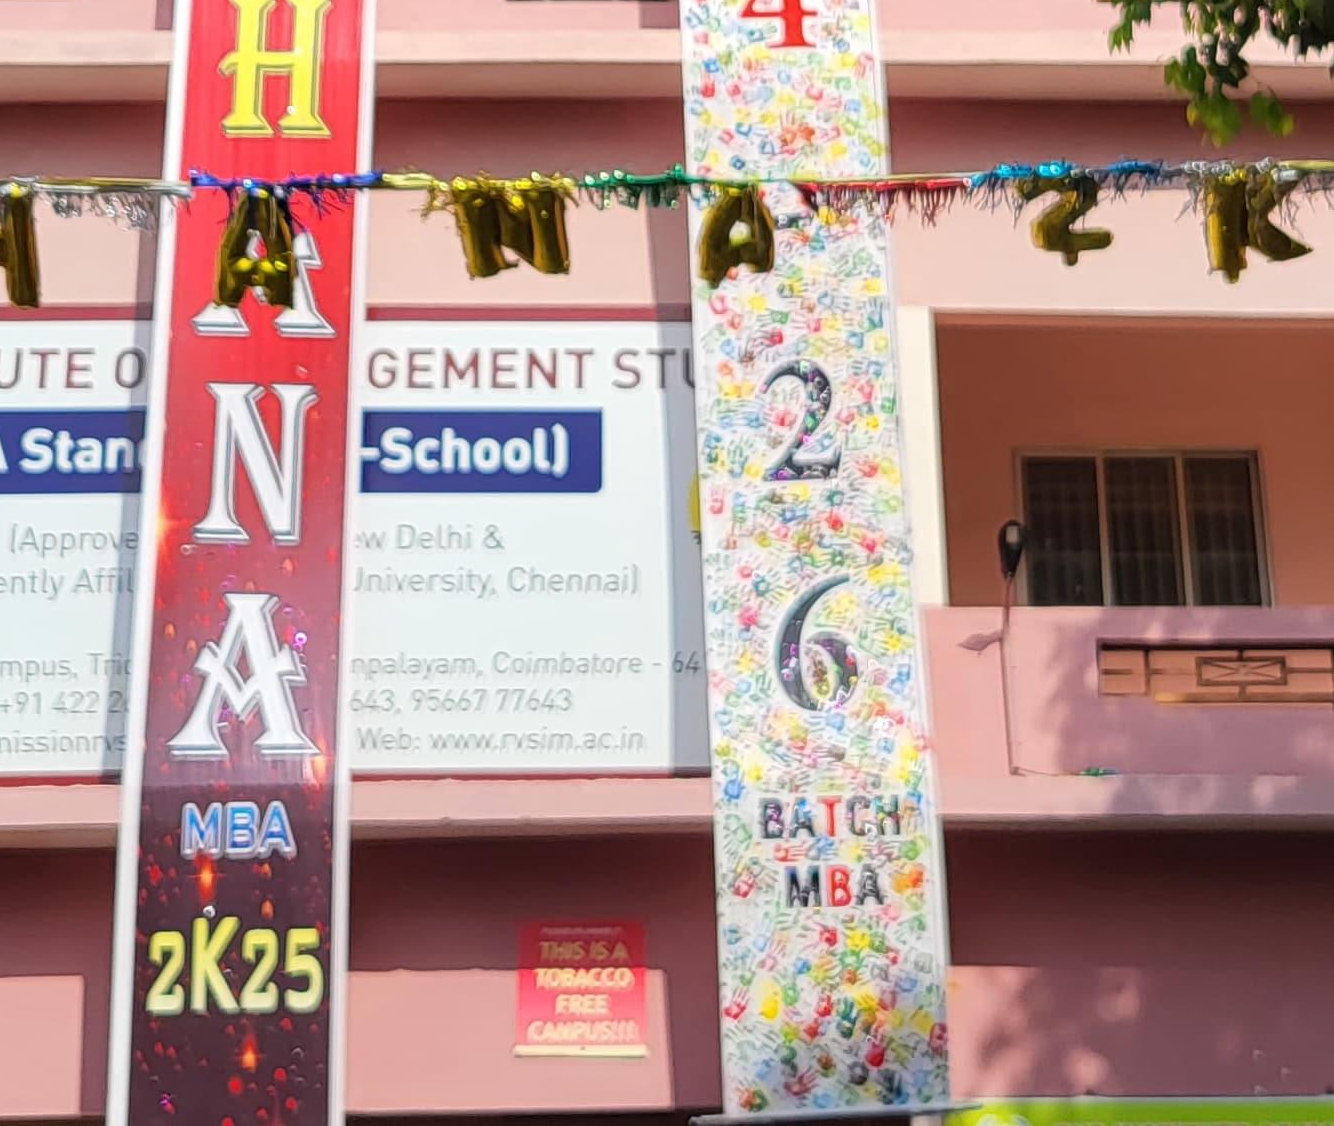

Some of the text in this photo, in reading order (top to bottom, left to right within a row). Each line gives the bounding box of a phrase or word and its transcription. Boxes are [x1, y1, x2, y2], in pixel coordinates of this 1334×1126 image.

[367, 347, 594, 390] GEMENT
[396, 523, 473, 550] Delhi
[482, 524, 505, 550] &
[507, 564, 641, 594] Chennai)
[492, 651, 643, 674] Coimbatore
[51, 691, 100, 714] 422
[411, 689, 487, 712] 95667
[495, 688, 572, 711] 77643
[357, 727, 420, 750] Web:
[430, 726, 644, 751] www.rvsim.ac.in
[180, 800, 297, 860] MBA
[757, 795, 902, 840] BATCH
[784, 864, 884, 908] MBA
[539, 940, 630, 960] THIS IS A
[145, 915, 325, 1015] 2K25
[535, 967, 635, 988] TOBACCO
[555, 994, 609, 1014] FREE
